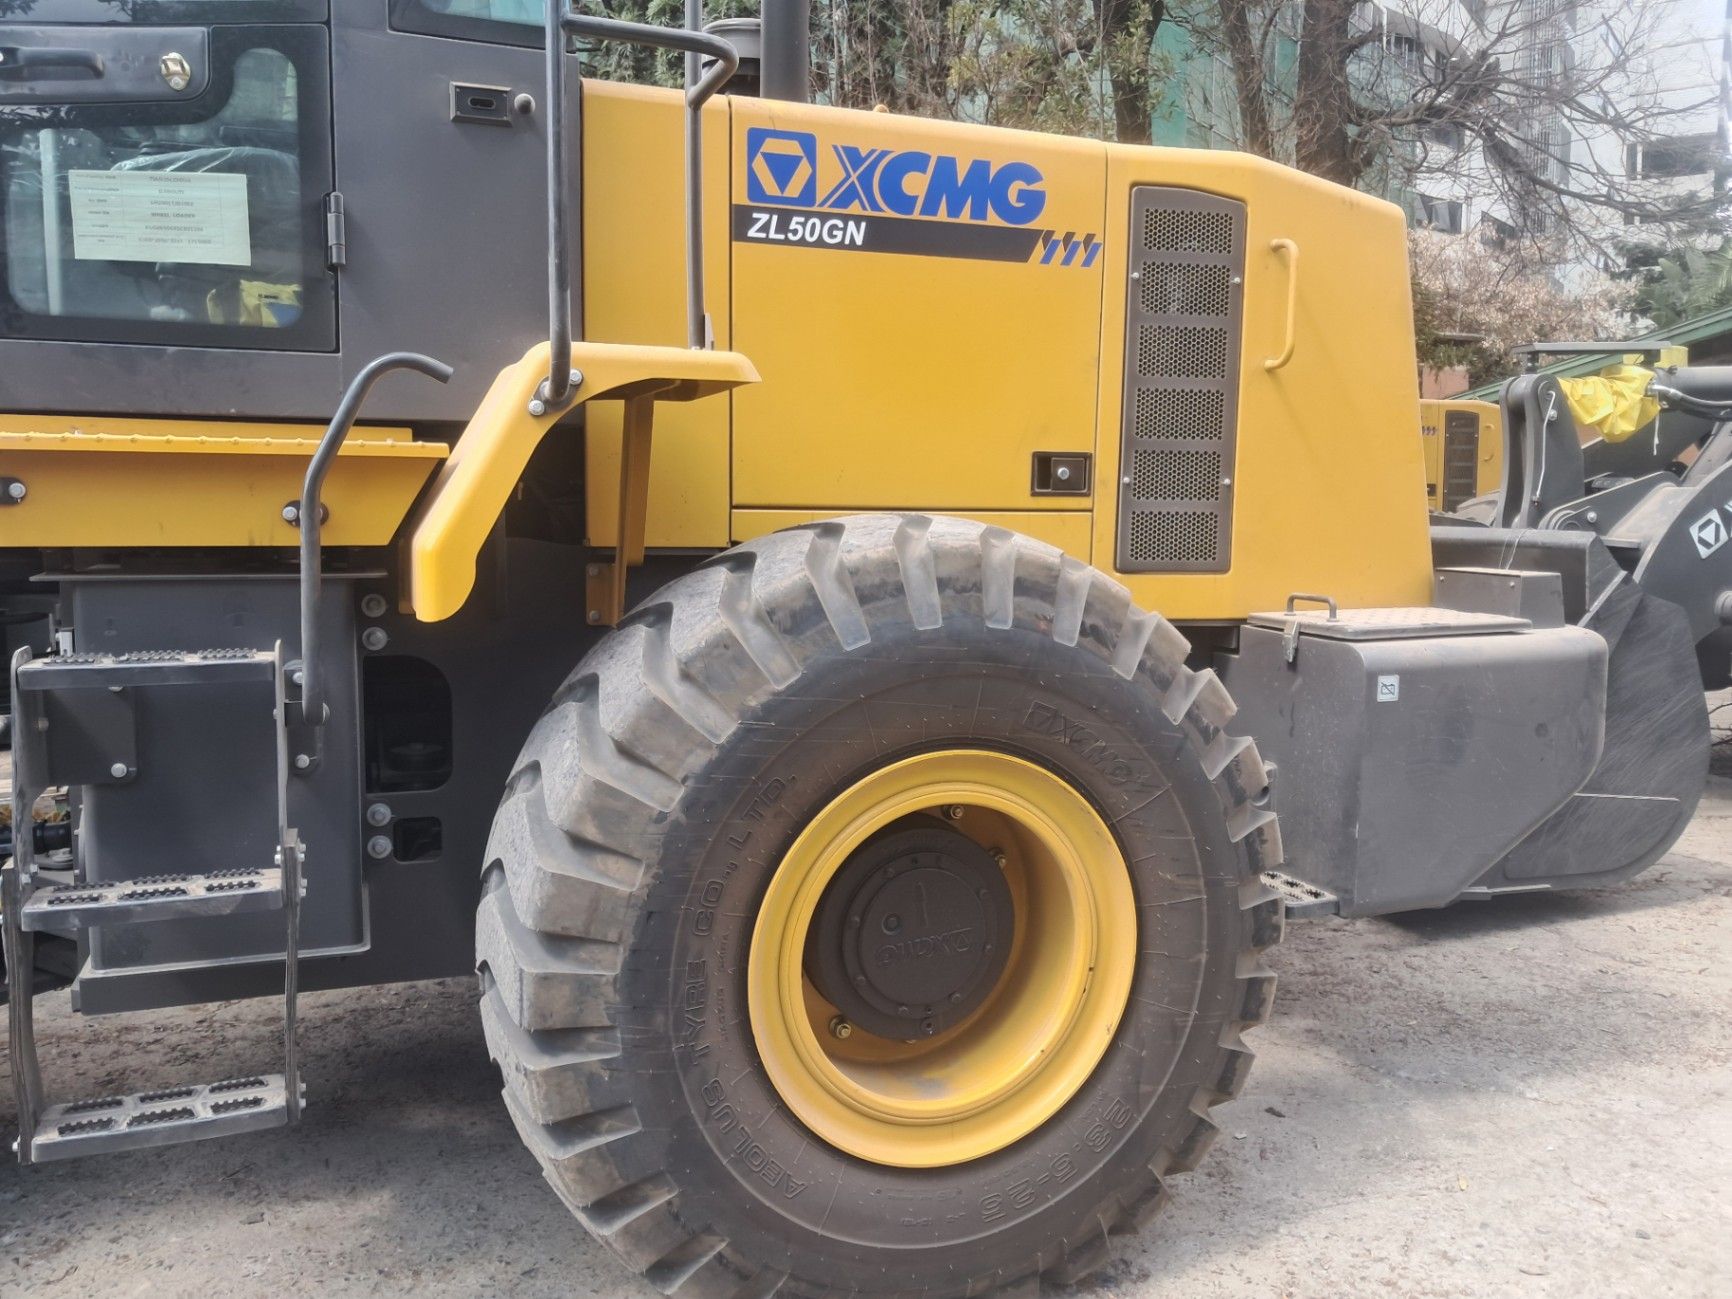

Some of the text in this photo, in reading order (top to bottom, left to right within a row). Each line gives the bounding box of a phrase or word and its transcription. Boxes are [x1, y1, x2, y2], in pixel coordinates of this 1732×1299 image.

[747, 213, 867, 247] ZL50GN
[817, 145, 1047, 226] XCMG
[684, 959, 712, 1065] TYRE
[701, 1077, 810, 1200] AEOLUS
[979, 1096, 1134, 1223] 23.5-25
